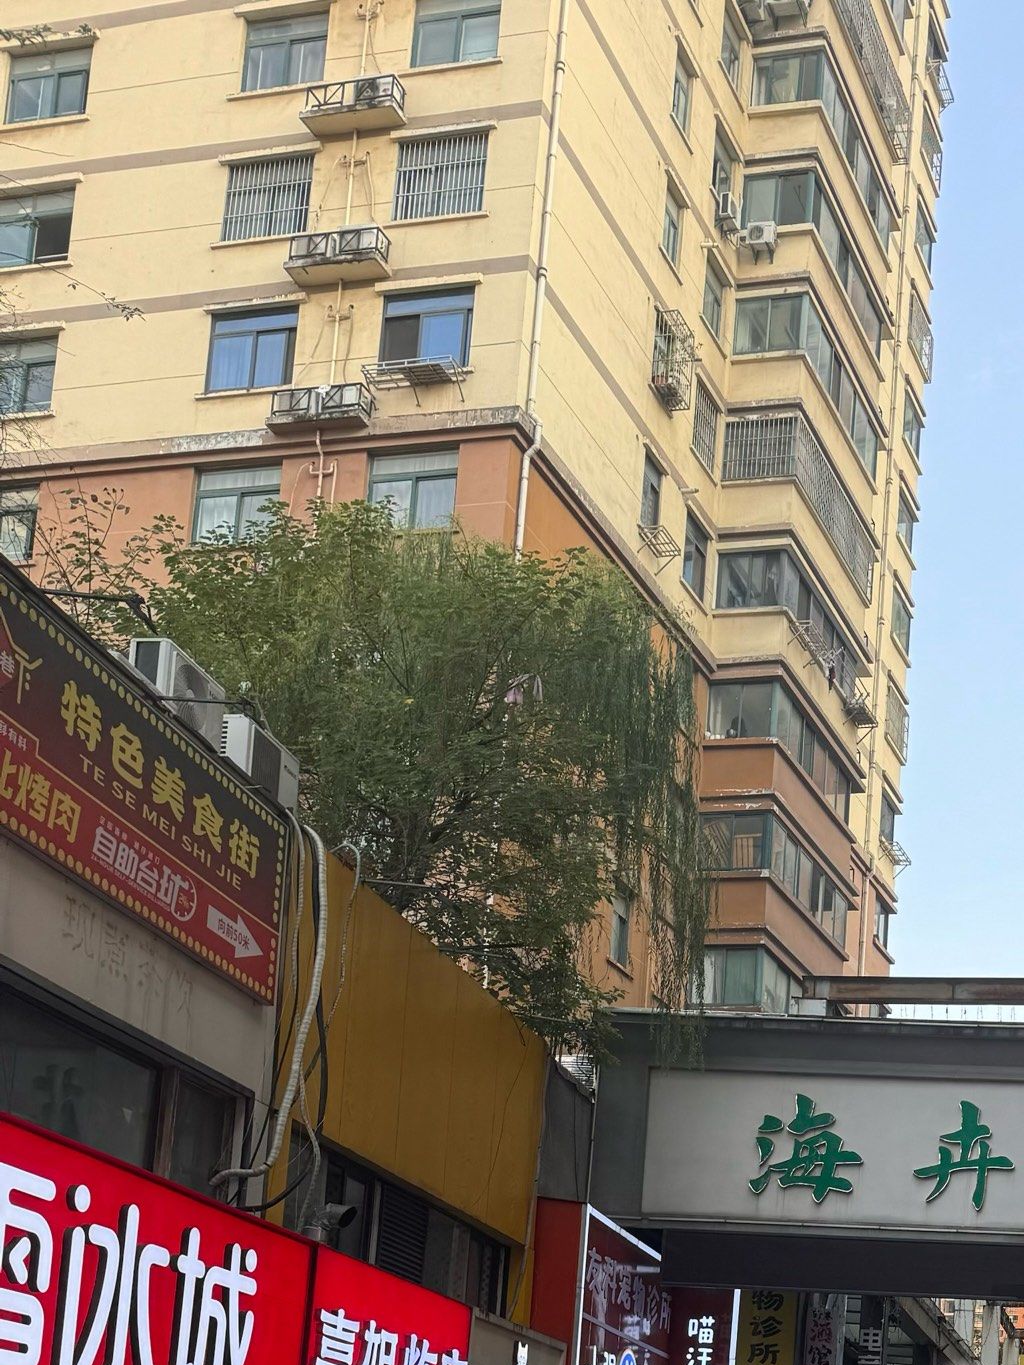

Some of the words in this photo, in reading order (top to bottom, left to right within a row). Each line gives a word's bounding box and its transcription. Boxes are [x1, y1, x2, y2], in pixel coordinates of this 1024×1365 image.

[61, 680, 260, 878] 特色美食街
[80, 754, 106, 788] TE
[112, 779, 137, 810] SE
[142, 804, 177, 841] MEI
[181, 834, 212, 868] SHI
[216, 864, 242, 892] JIE
[217, 917, 250, 951] 向前50米
[747, 1289, 785, 1365] 物诊所
